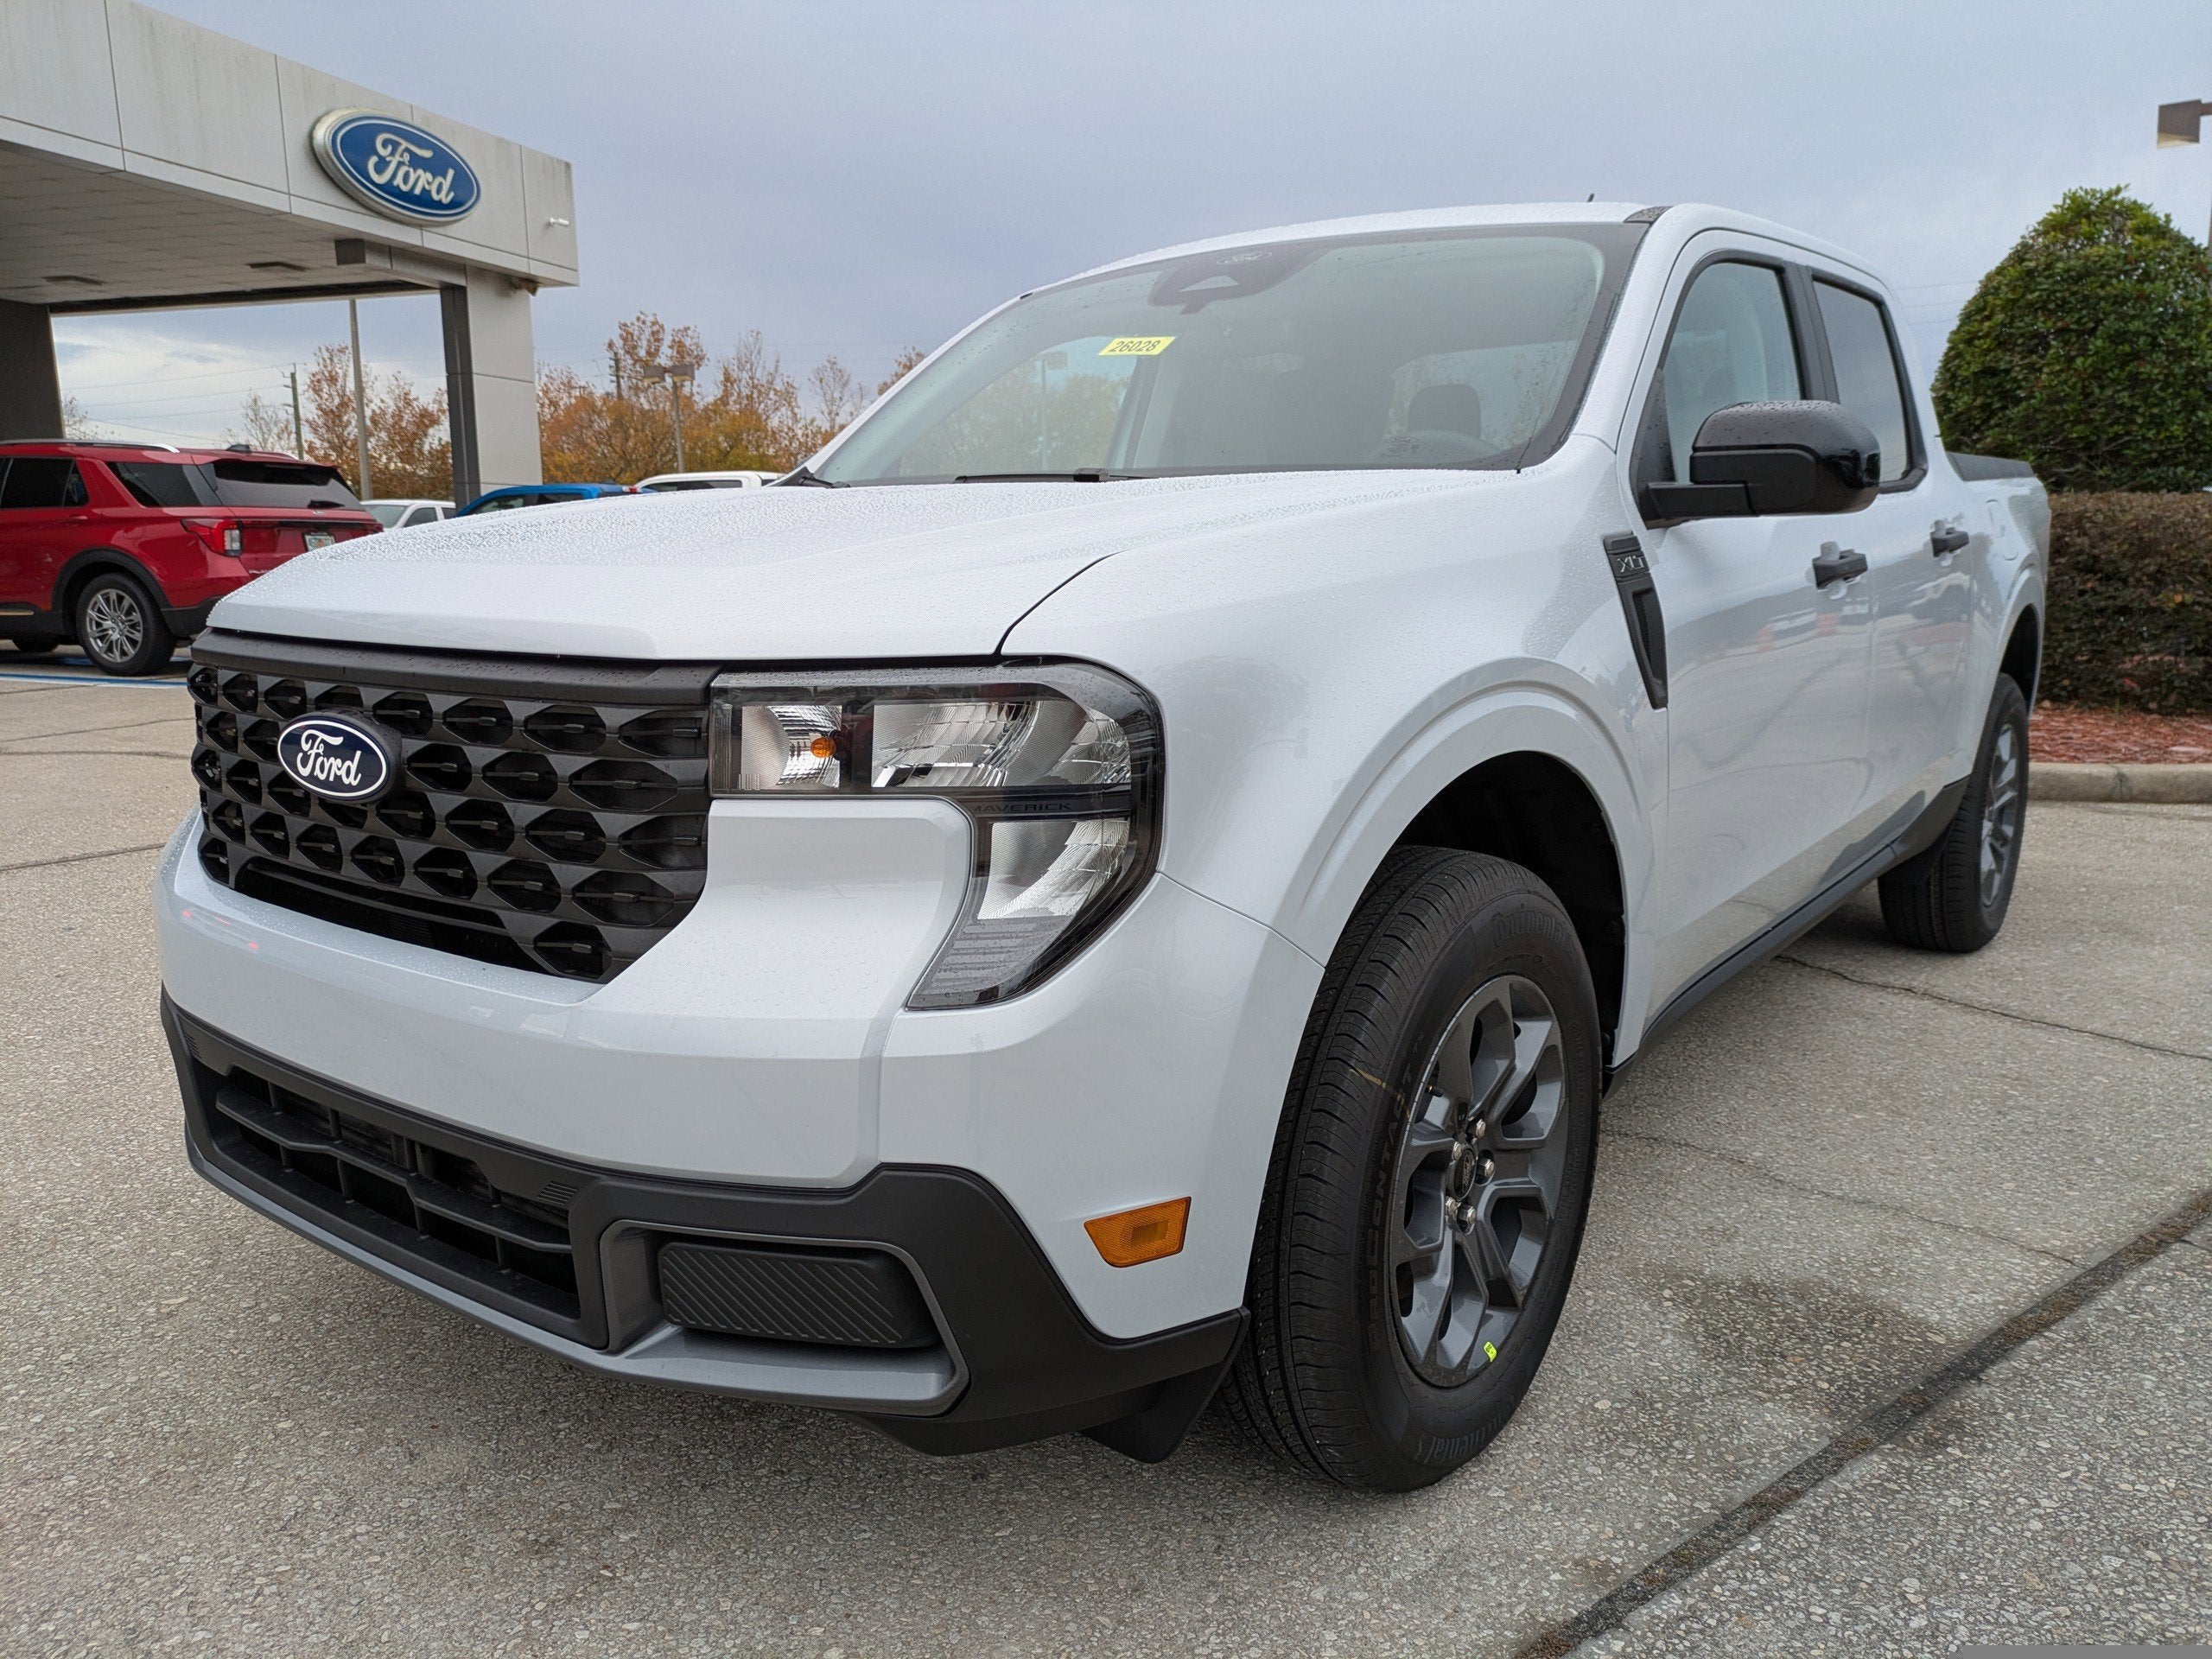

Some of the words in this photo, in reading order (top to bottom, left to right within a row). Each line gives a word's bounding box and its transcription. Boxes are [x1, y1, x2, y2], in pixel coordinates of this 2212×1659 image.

[367, 133, 455, 204] Ford
[1108, 340, 1161, 353] 26028
[1616, 555, 1644, 573] XLT
[296, 728, 362, 786] Ford
[970, 803, 1071, 814] MAVERICK
